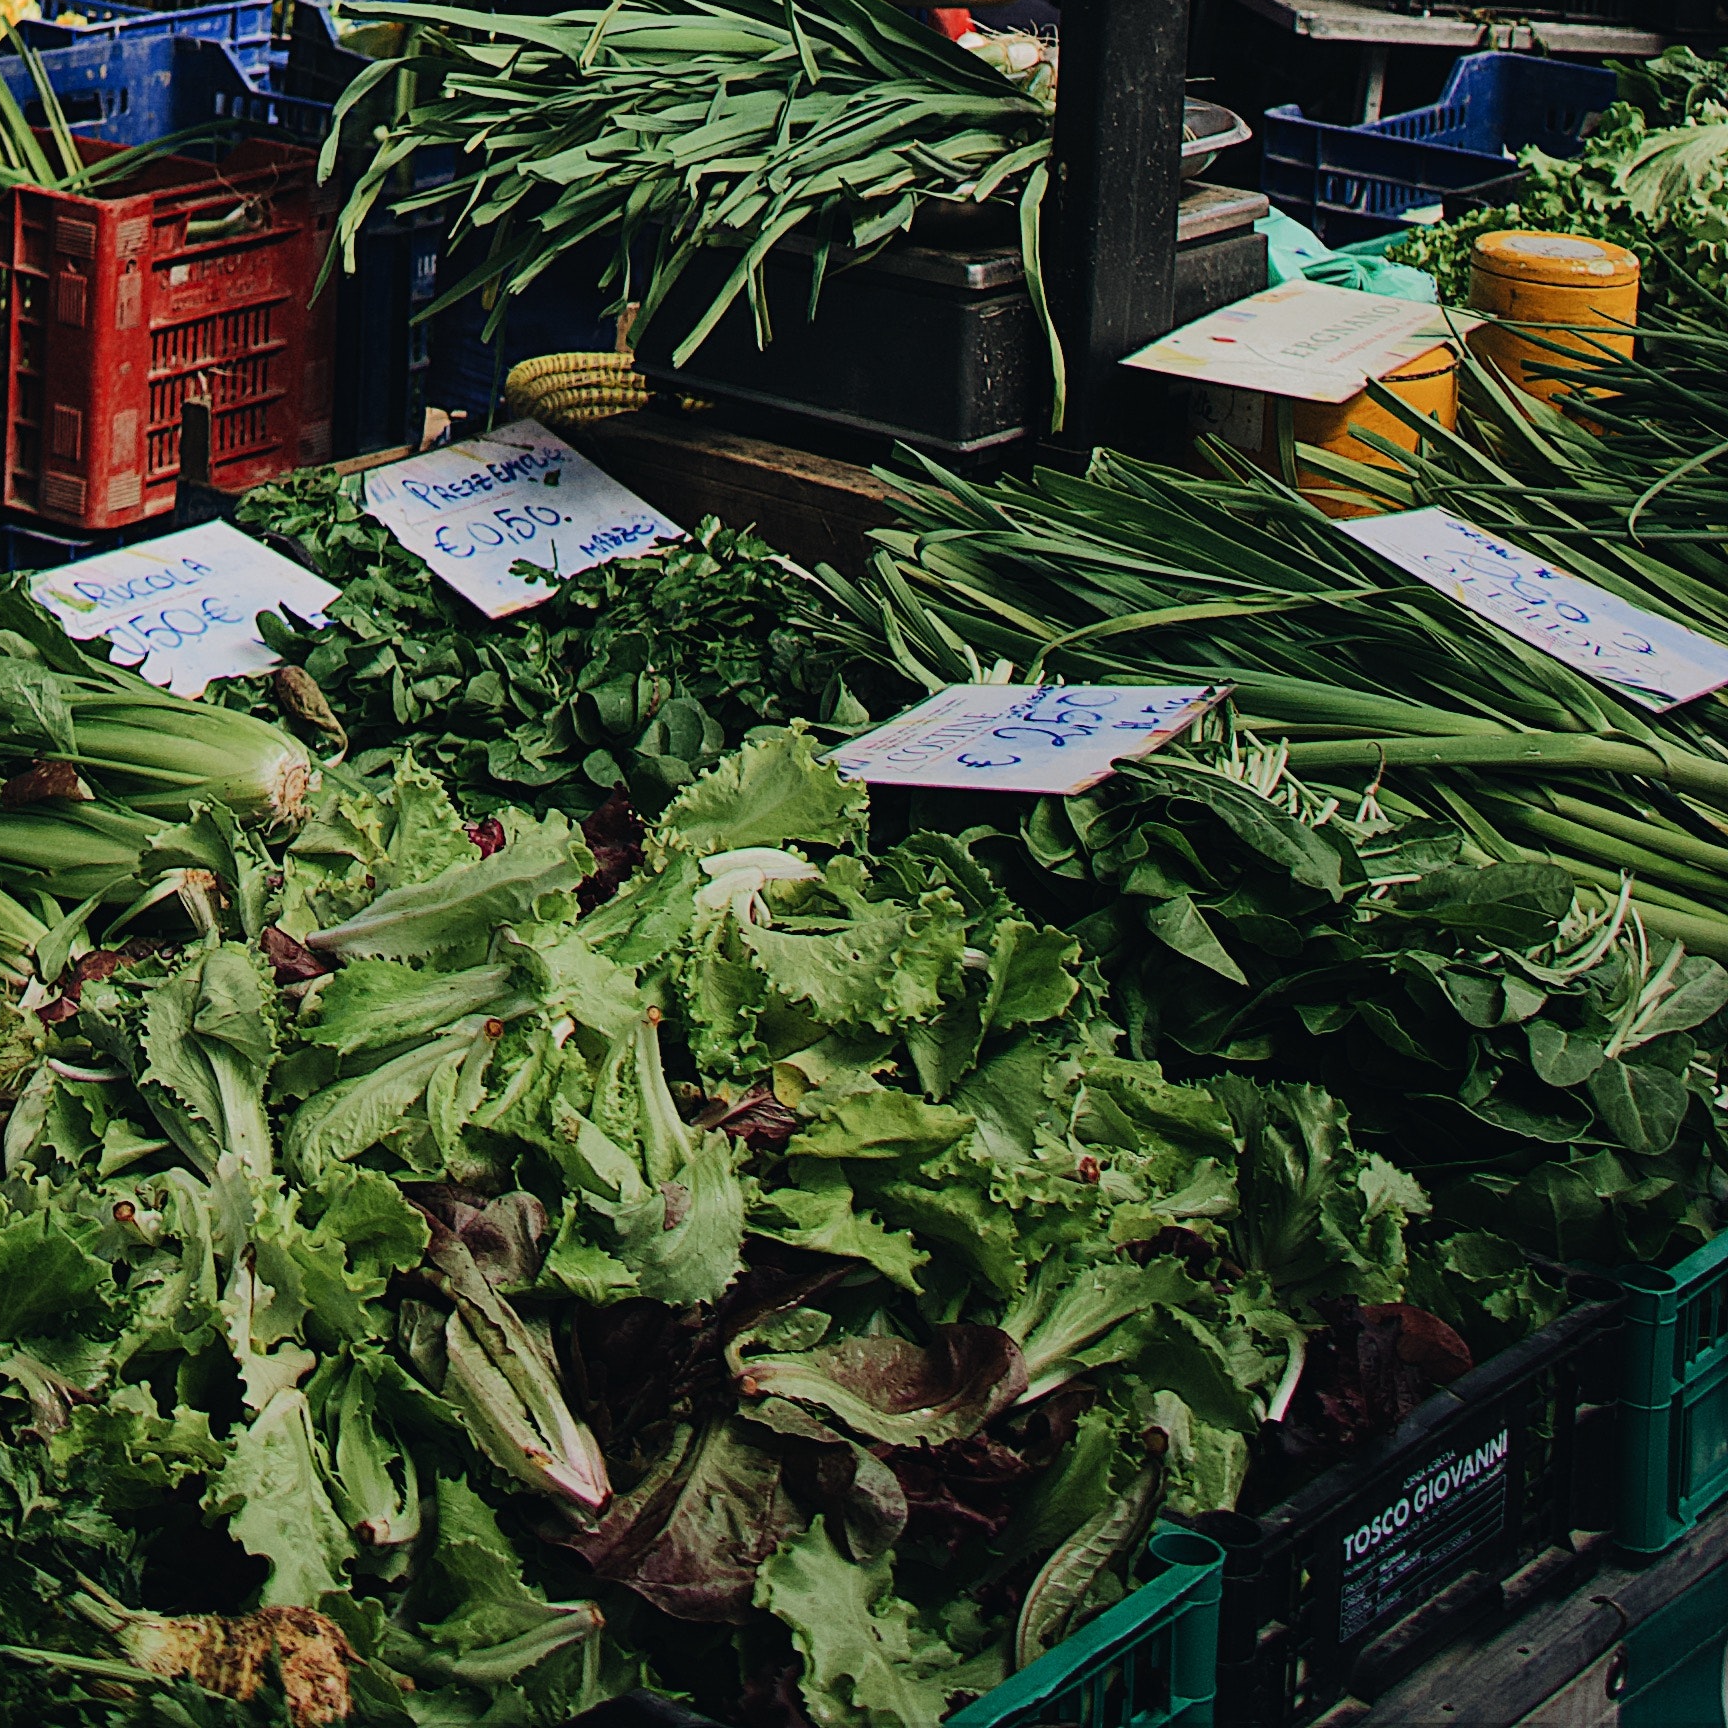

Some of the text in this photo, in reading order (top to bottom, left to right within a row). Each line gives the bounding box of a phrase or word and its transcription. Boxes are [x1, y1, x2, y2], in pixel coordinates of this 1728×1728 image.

[73, 557, 212, 609] RUCOLA
[1422, 554, 1622, 659] AGLIETTO
[886, 712, 1003, 763] COSTINE
[1342, 1497, 1410, 1562] TOSCO
[1413, 1427, 1509, 1514] GIOVANNI
